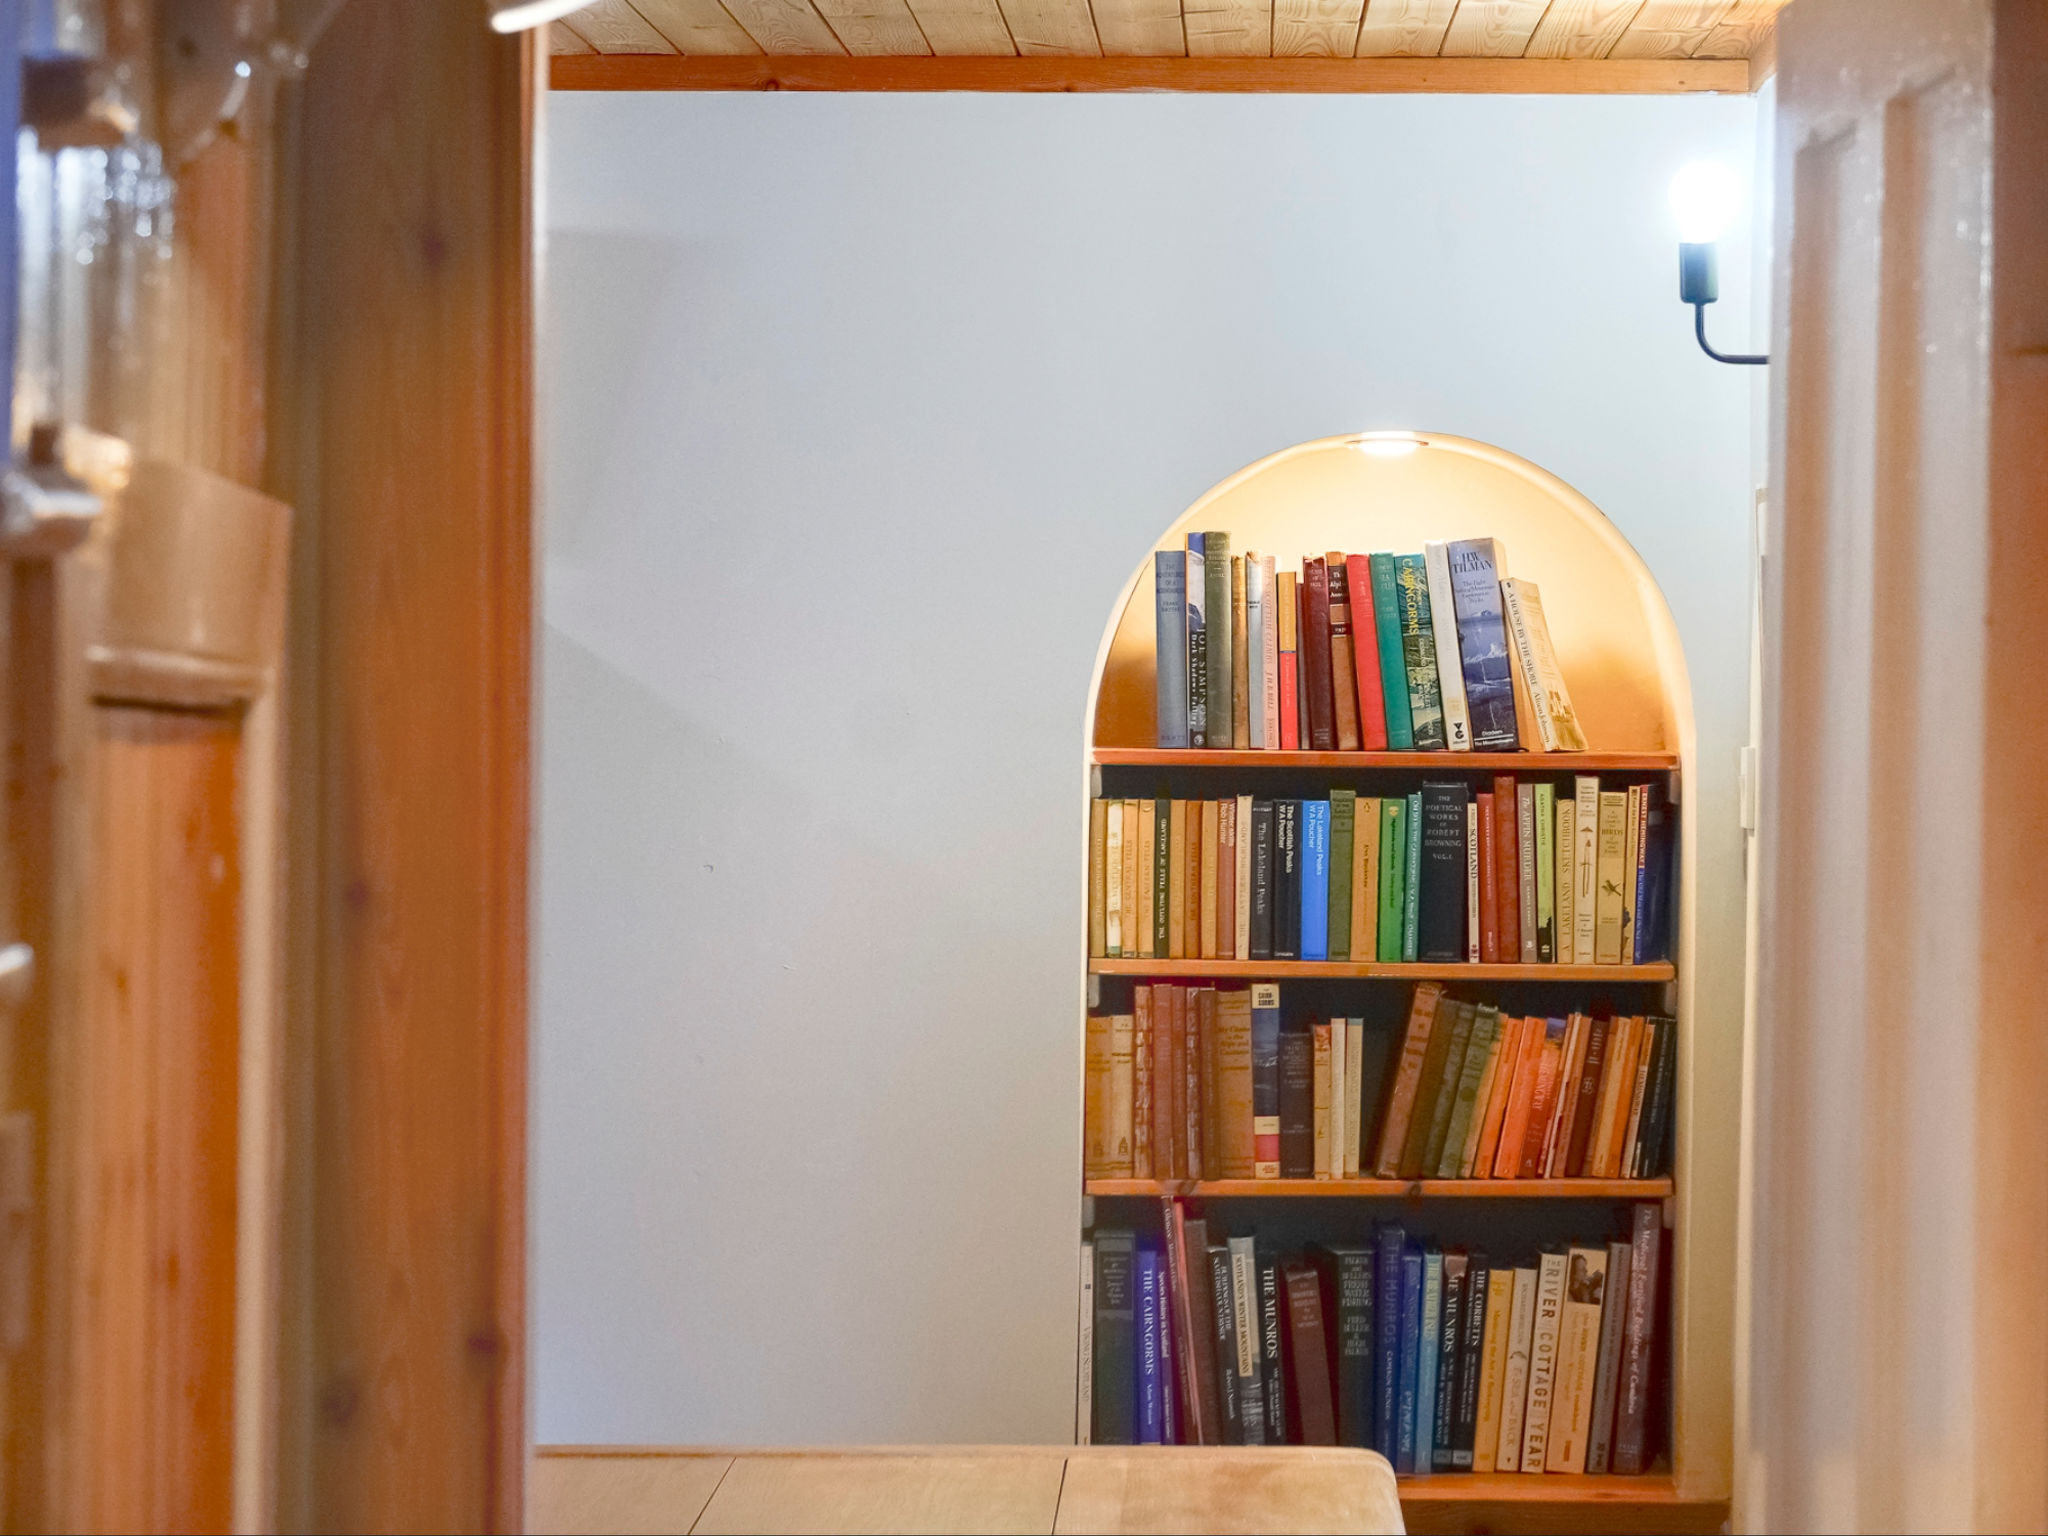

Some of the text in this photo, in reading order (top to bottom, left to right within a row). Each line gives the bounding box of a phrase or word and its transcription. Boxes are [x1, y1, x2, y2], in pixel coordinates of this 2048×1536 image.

[1451, 559, 1493, 574] TILMAN
[1402, 558, 1420, 635] CAIRNGORMS
[1509, 597, 1522, 628] HOUSE
[1520, 641, 1531, 657] THE
[1525, 659, 1538, 687] SHORE
[1257, 822, 1266, 841] The
[1278, 820, 1286, 849] Poucher
[1286, 805, 1294, 873] The Scottish Peaks
[1315, 805, 1324, 876] The Lakeland Peaks
[1424, 839, 1462, 847] BROWNING
[1522, 810, 1531, 837] APPIN
[1561, 809, 1570, 874] SKETCHBOOK
[1639, 820, 1647, 863] HEMINGWAY
[1257, 843, 1266, 885] Lakeland
[1470, 828, 1478, 879] SCOTLAND
[1522, 840, 1532, 881] MURDER
[1257, 888, 1266, 915] Peaks
[1562, 882, 1570, 935] LAKELAND
[1158, 1271, 1167, 1295] Species
[1384, 1245, 1398, 1344] THE MUNROS
[1142, 1269, 1154, 1375] THE CAIRNGORMS
[1238, 1301, 1248, 1328] WINTER
[1262, 1266, 1278, 1359] THE MUNROS
[1443, 1296, 1458, 1353] MUNROS
[1472, 1270, 1486, 1346] THE CORBETTS
[1160, 1329, 1169, 1358] Scotland
[1240, 1330, 1251, 1373] MOUNTAINS
[1580, 1328, 1588, 1352] RIVER
[1630, 1316, 1644, 1359] Buildings
[1385, 1350, 1393, 1386] CAMERON
[1527, 1268, 1561, 1468] RIVER COTTAGE YEAR
[1628, 1375, 1639, 1414] Cumbria
[1506, 1419, 1518, 1445] BACK
